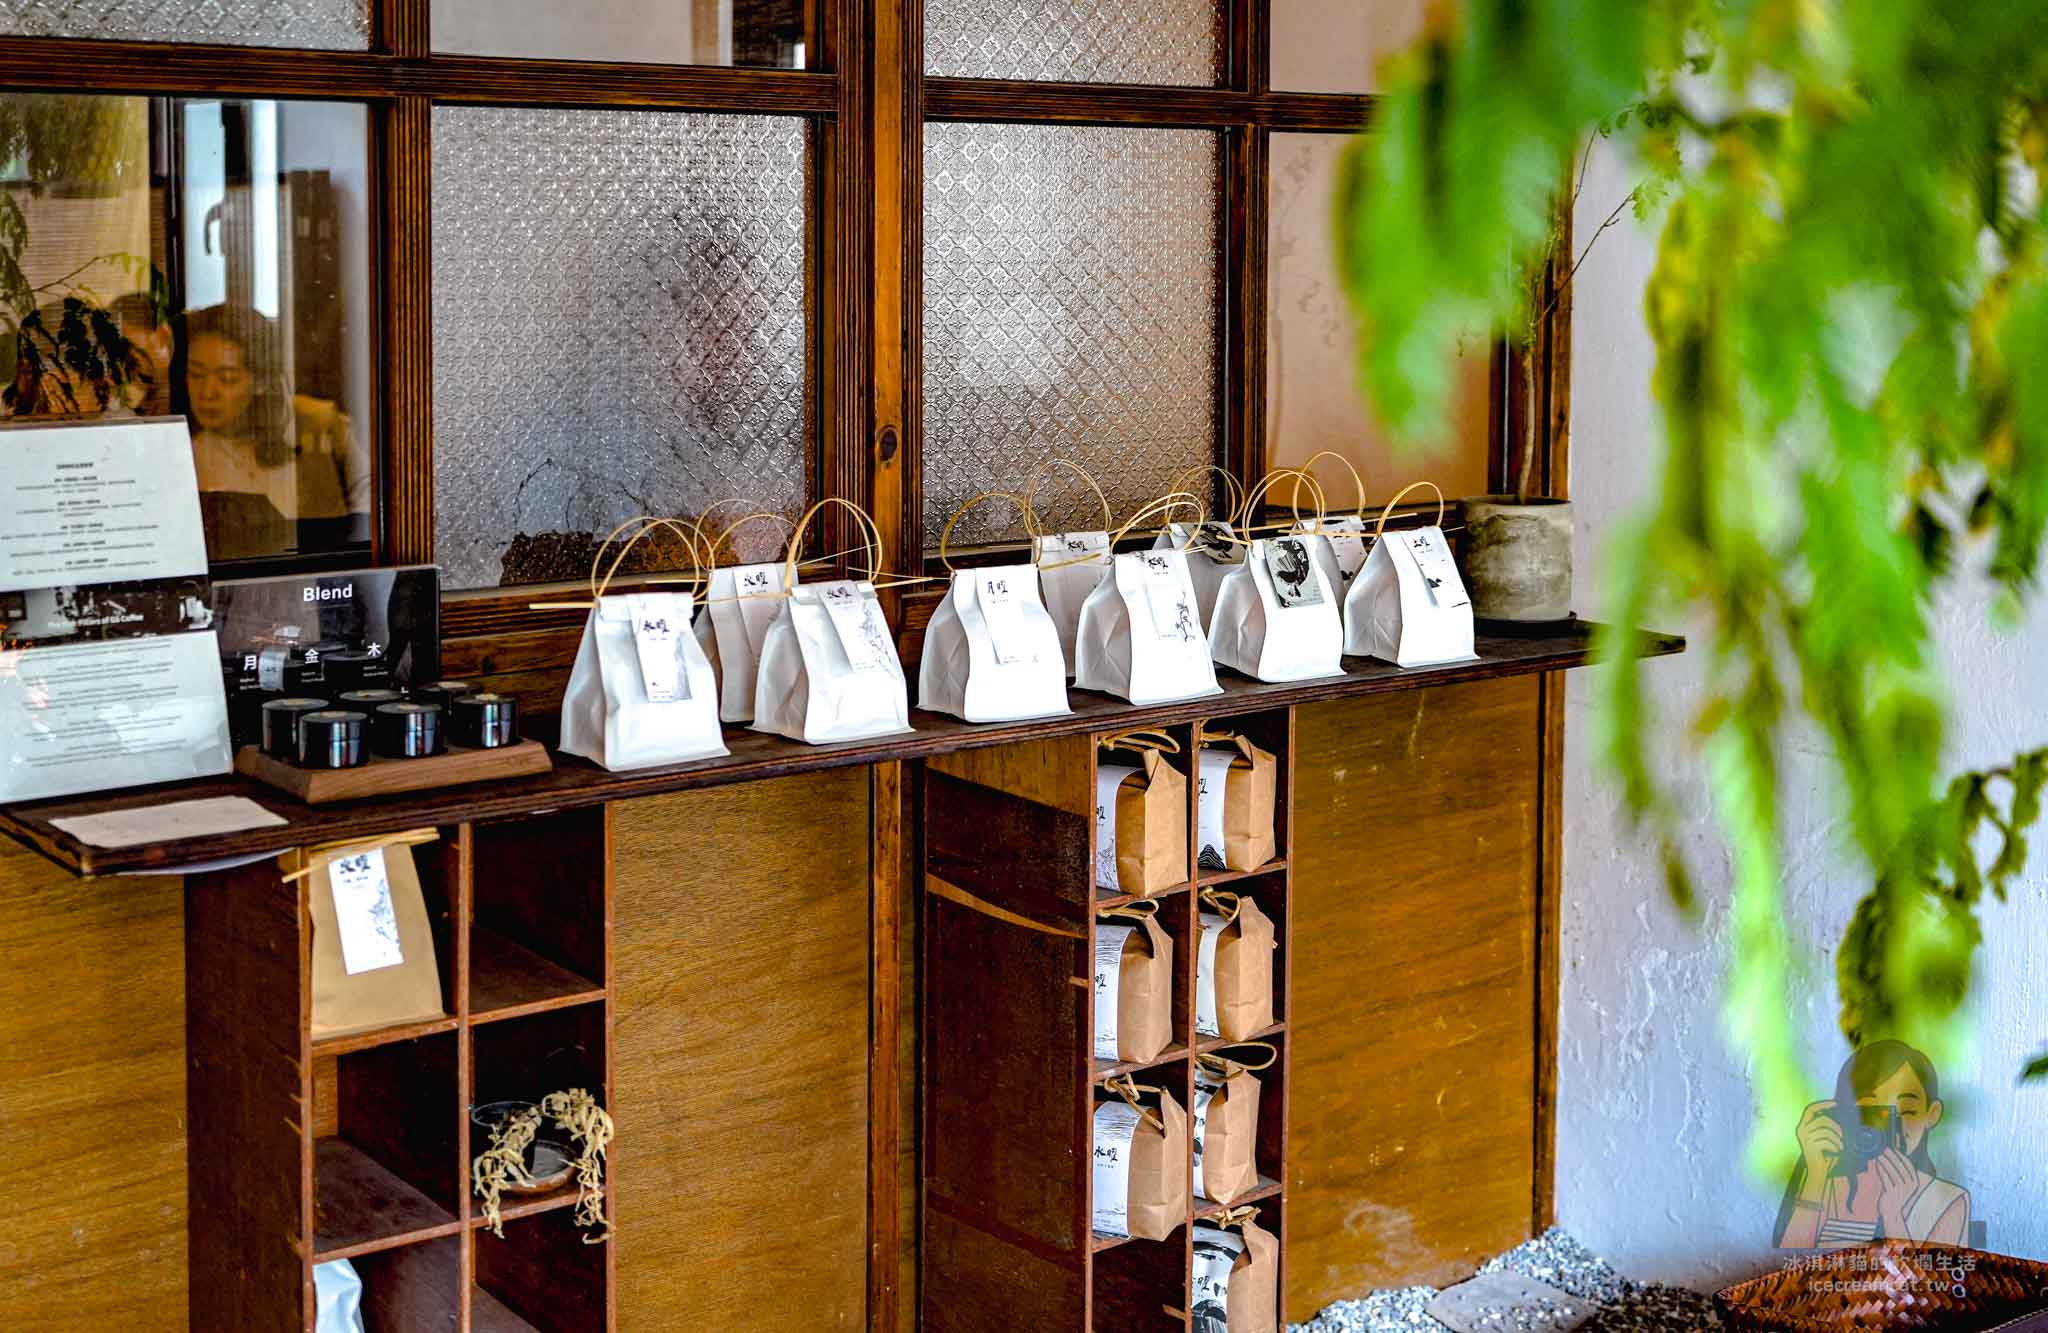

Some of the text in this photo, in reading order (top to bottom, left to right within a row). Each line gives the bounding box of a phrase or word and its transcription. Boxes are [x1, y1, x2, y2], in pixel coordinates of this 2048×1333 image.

[303, 583, 353, 602] Blend
[304, 648, 319, 664] 金
[367, 642, 382, 657] 木
[243, 655, 257, 671] 月
